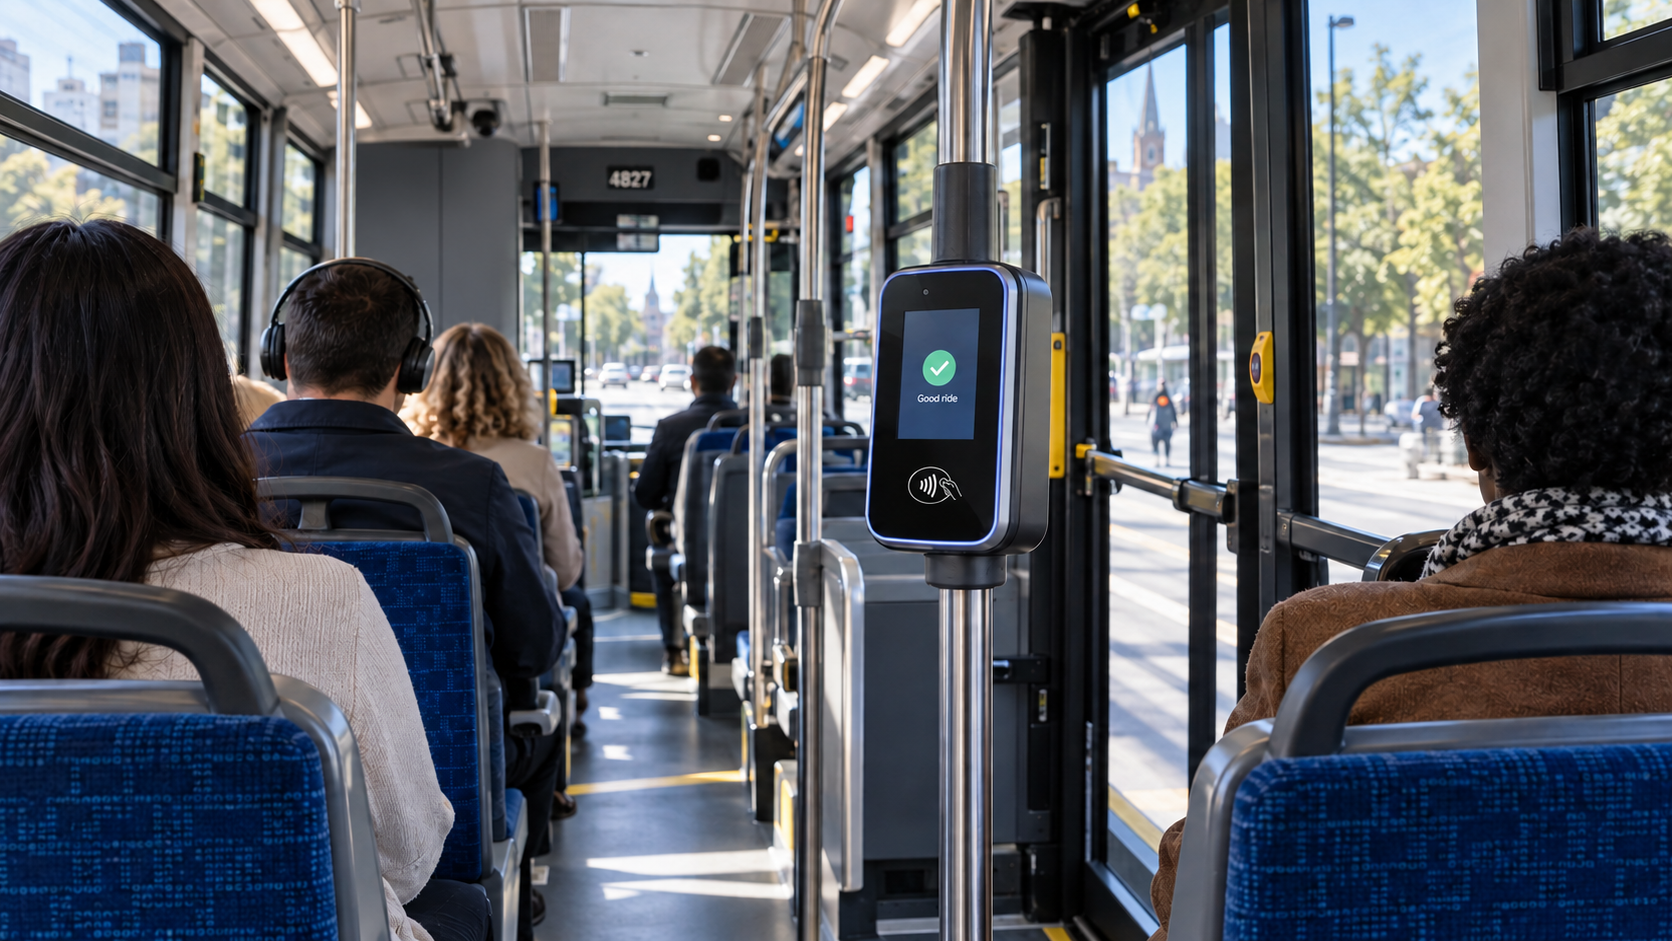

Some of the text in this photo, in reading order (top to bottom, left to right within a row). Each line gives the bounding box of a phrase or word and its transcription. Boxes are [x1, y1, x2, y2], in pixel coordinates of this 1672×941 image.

[609, 170, 652, 188] 4827
[917, 394, 958, 403] Good ride
